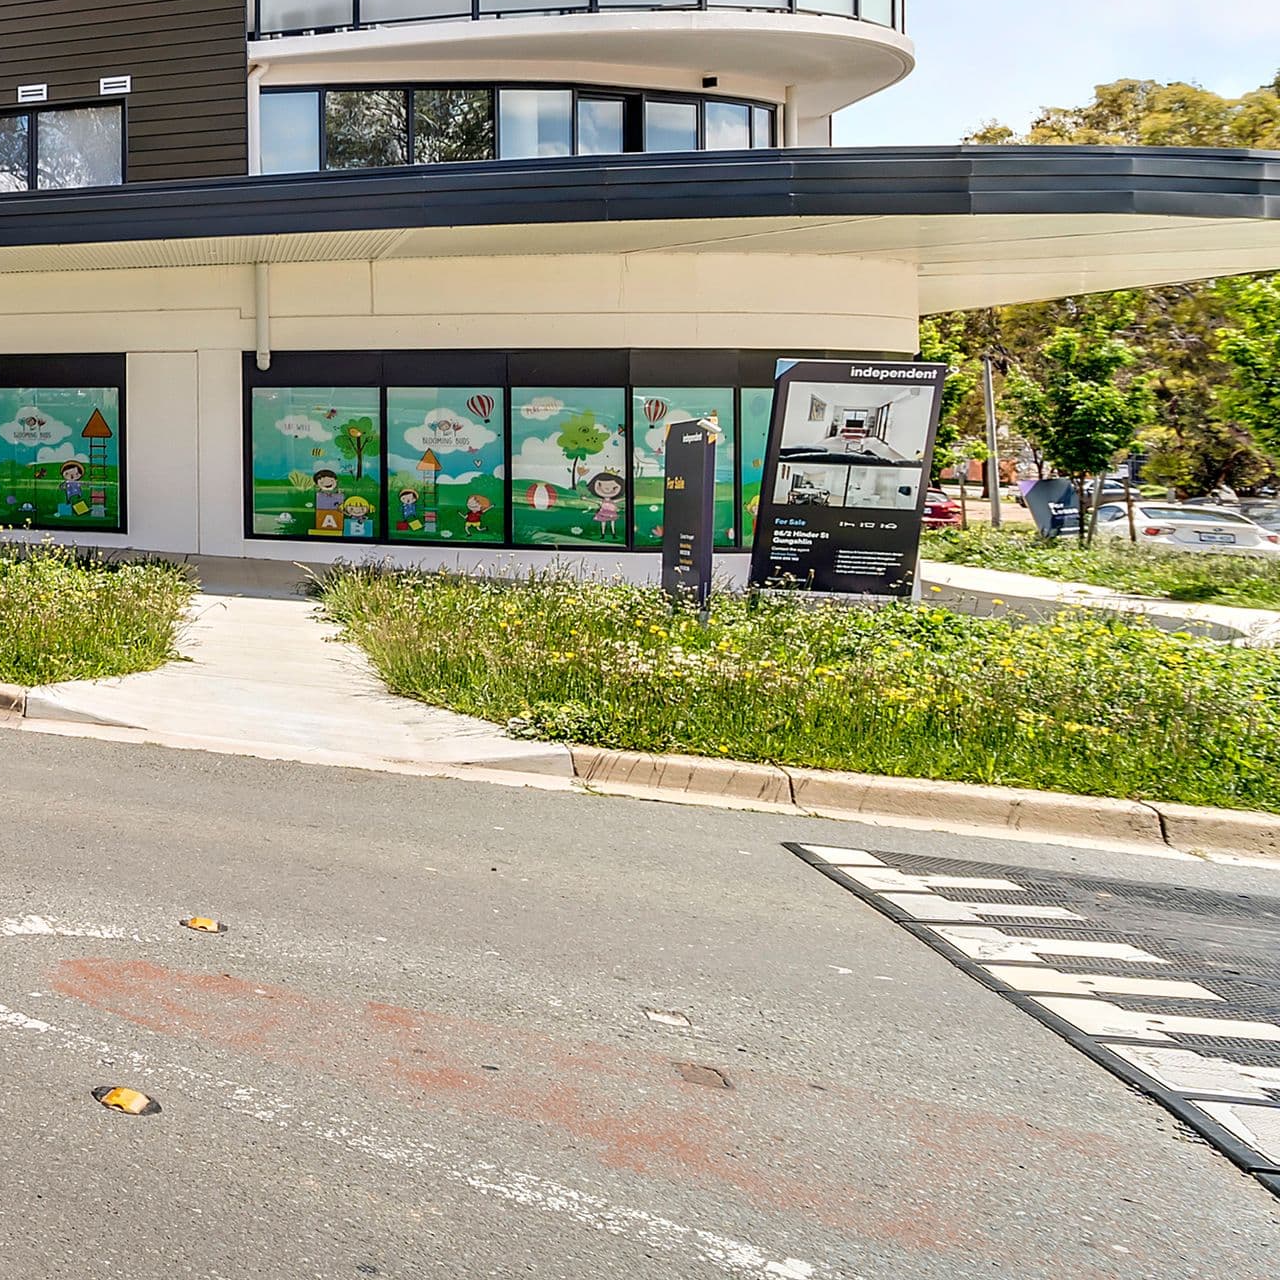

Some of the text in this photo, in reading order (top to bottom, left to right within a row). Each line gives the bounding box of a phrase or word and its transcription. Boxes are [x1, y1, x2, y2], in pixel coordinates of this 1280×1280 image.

[850, 366, 938, 381] independent
[321, 514, 338, 528] A
[774, 517, 807, 526] For Sale
[792, 530, 820, 539] Hinder
[819, 531, 830, 540] St
[772, 536, 813, 546] Gungahlin
